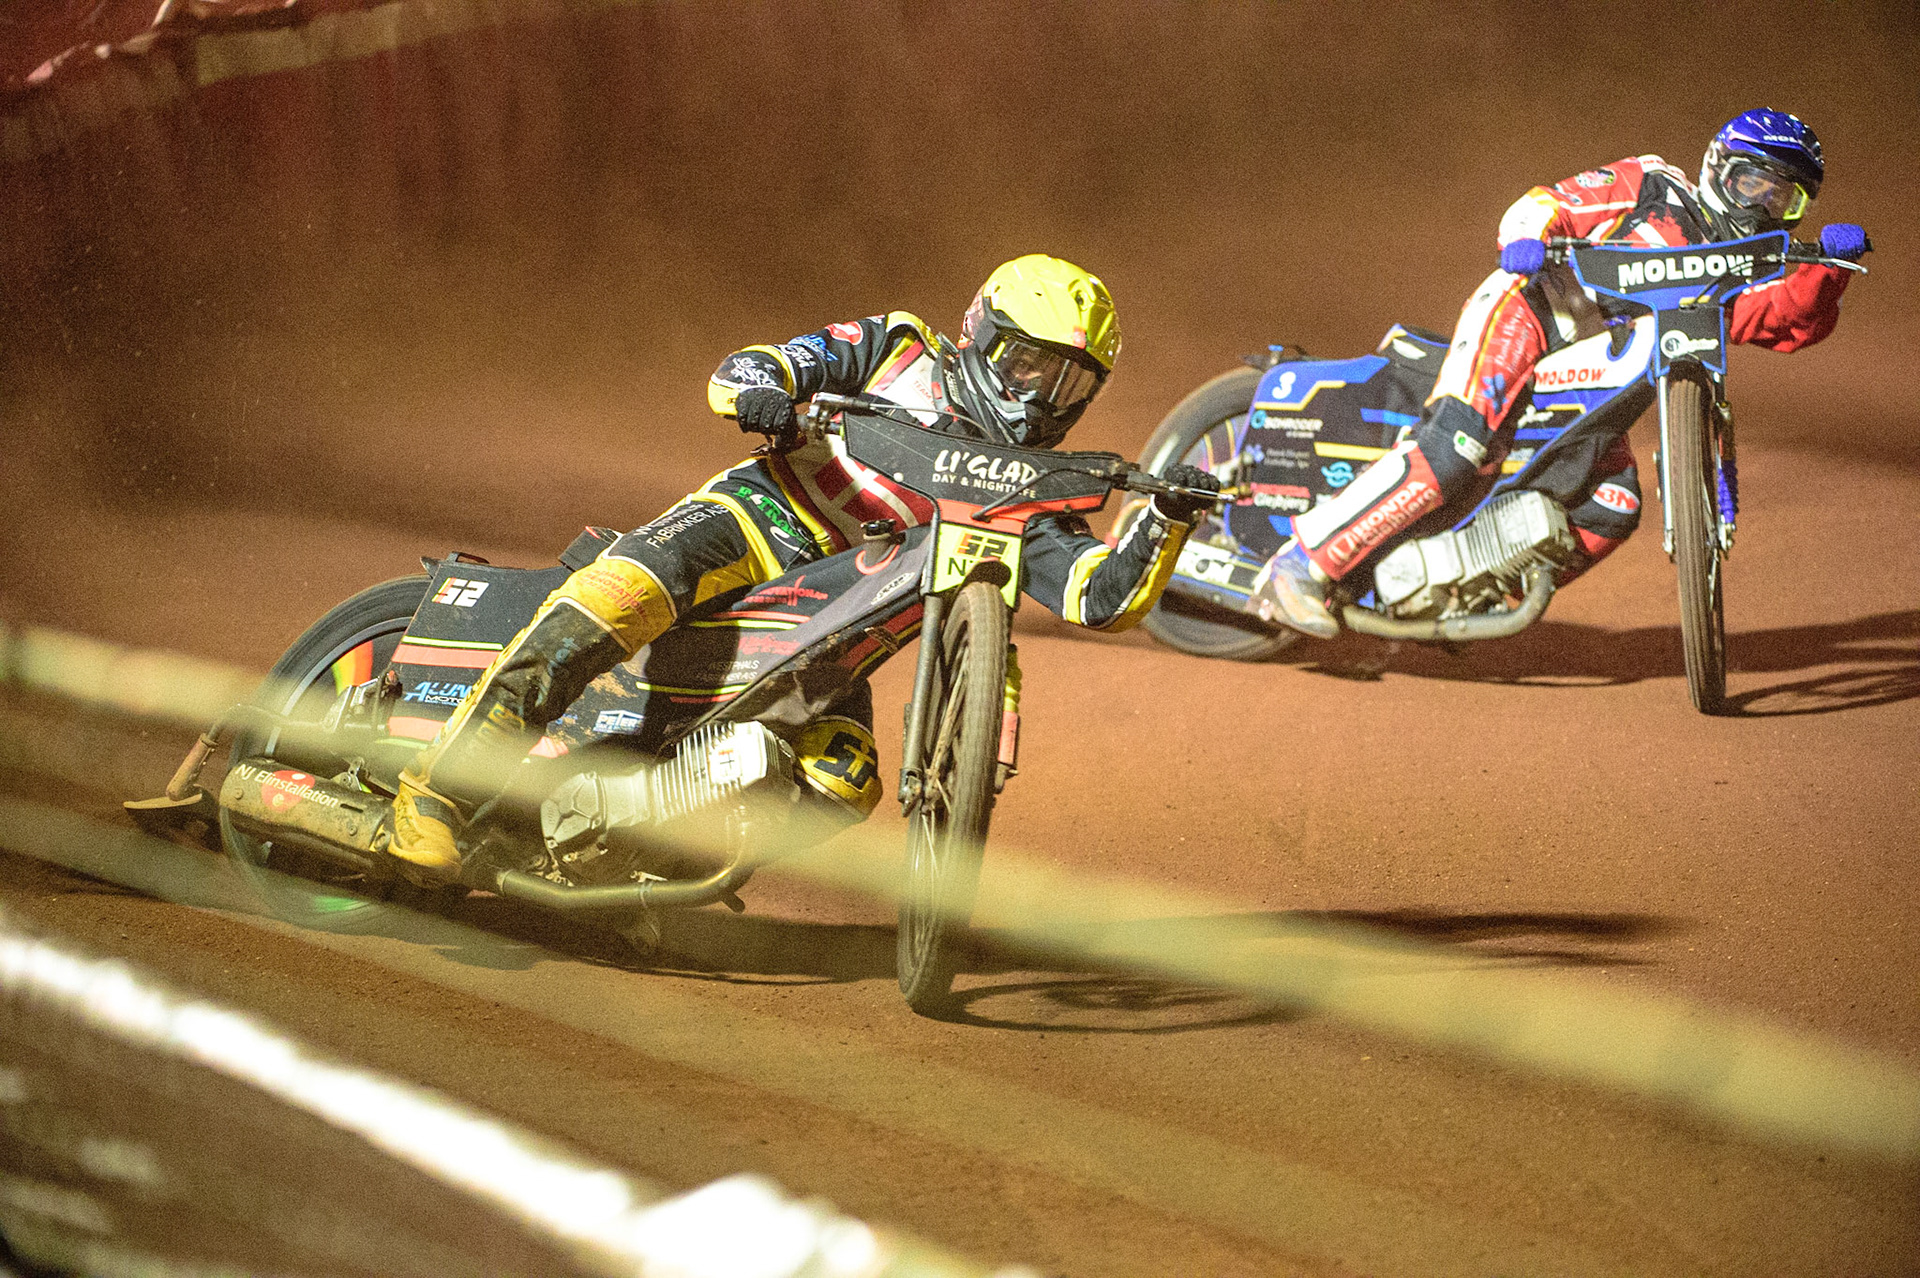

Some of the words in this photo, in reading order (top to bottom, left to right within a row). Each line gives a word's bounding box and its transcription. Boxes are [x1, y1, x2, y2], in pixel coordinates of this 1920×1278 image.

[1617, 254, 1754, 288] MOLDOW
[1535, 368, 1607, 386] MOLDOW
[932, 473, 957, 484] DAY
[960, 476, 969, 487] &
[1352, 481, 1428, 538] HONDA
[957, 533, 1008, 559] 52
[432, 576, 490, 608] 52
[234, 763, 257, 781] NJ
[254, 769, 340, 808] Elinstallation
